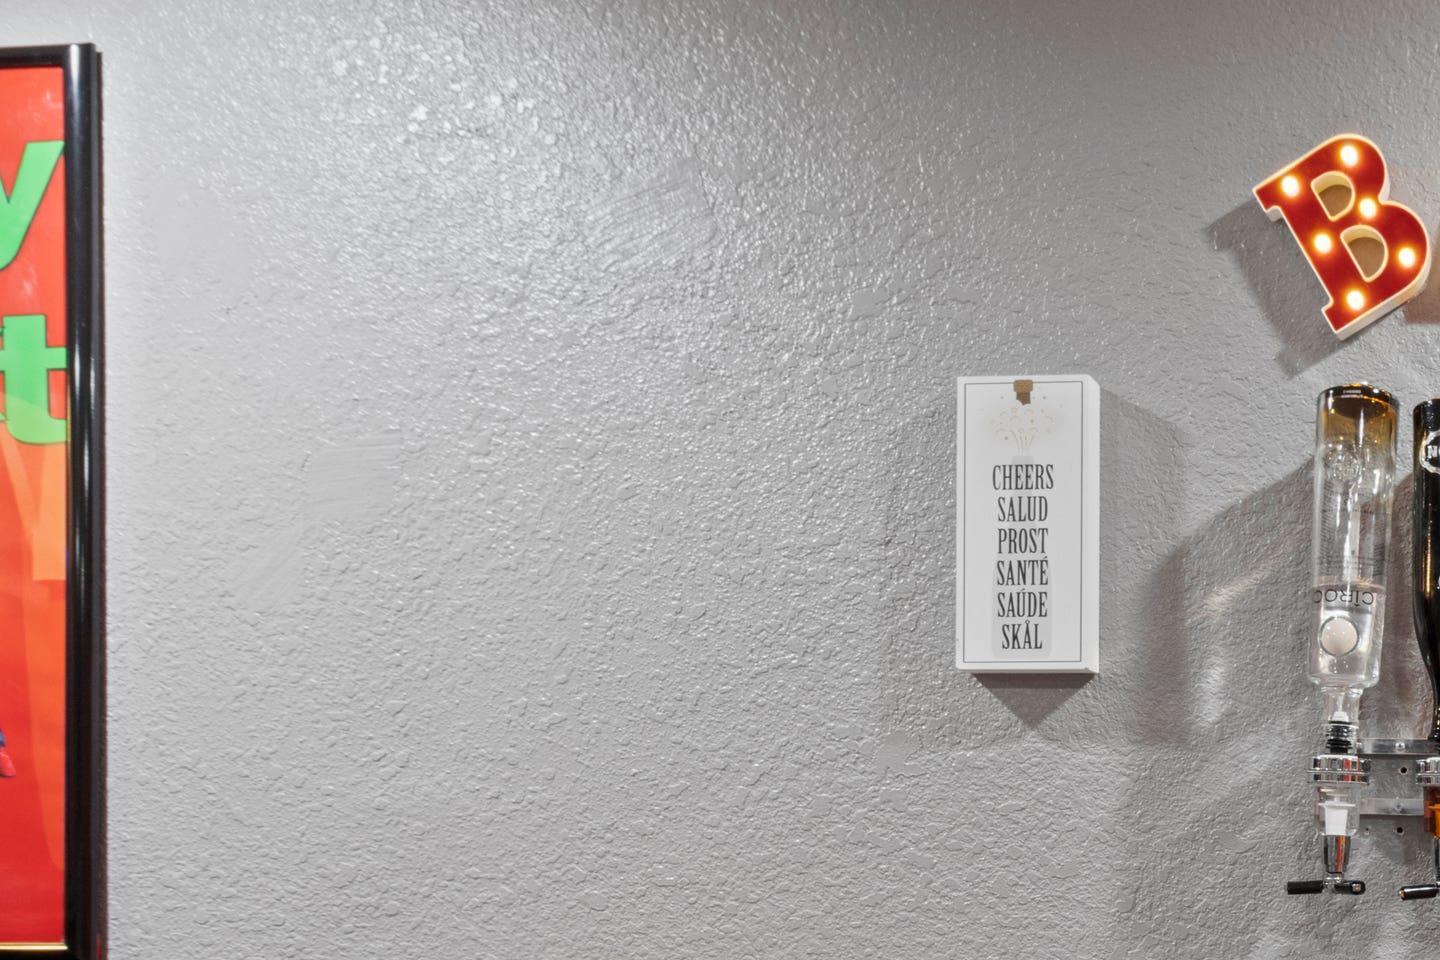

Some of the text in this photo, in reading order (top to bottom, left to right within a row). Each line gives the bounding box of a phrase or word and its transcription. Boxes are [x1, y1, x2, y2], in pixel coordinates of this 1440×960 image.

[992, 464, 1054, 490] CHEERS
[997, 496, 1048, 522] SALUD
[997, 527, 1048, 554] PROST
[996, 556, 1049, 586] SANTÉ
[997, 588, 1047, 618] SAÚDE
[1002, 619, 1043, 649] SKÅL
